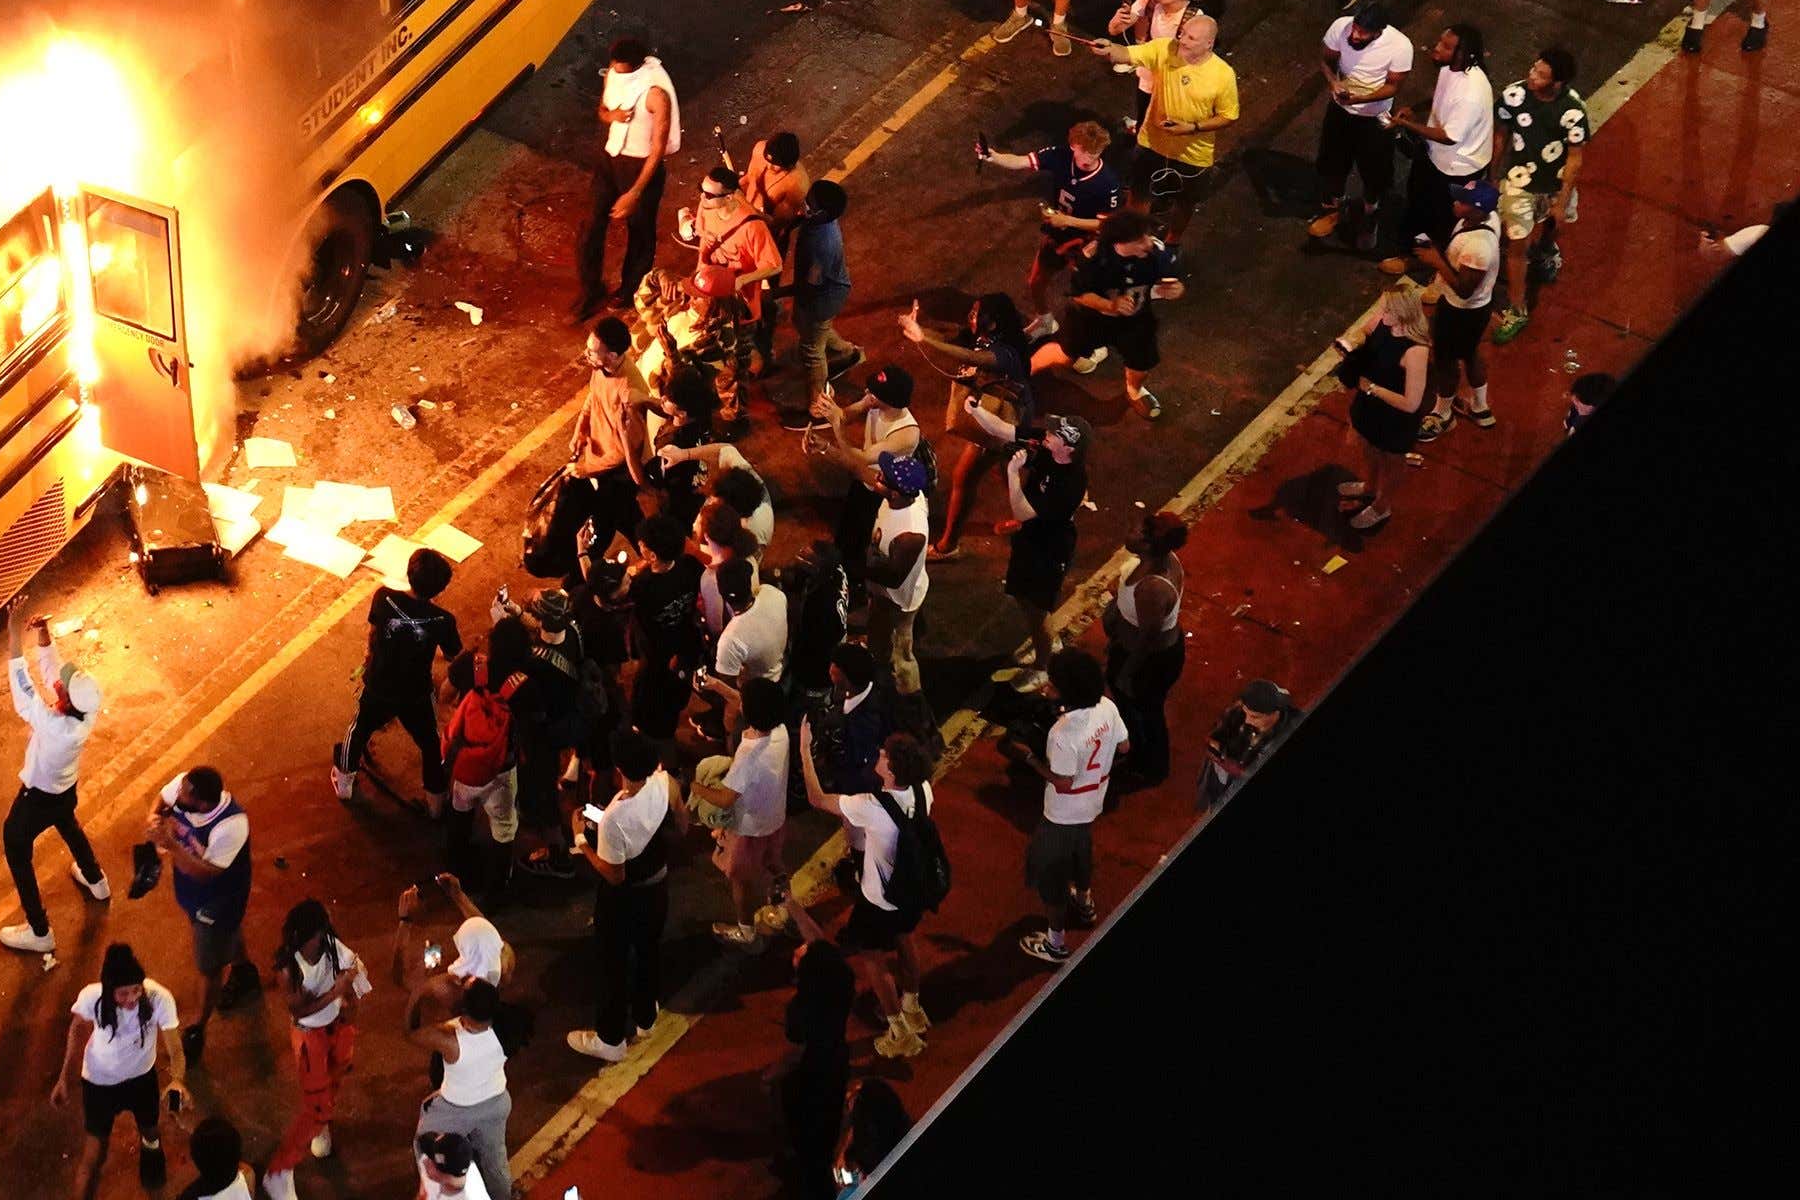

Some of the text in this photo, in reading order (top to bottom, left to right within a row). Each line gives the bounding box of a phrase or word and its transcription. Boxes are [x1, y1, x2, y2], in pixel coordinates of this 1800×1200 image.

[302, 25, 413, 137] STUDENT INC.
[1110, 196, 1118, 208] 5
[1086, 738, 1102, 771] 2
